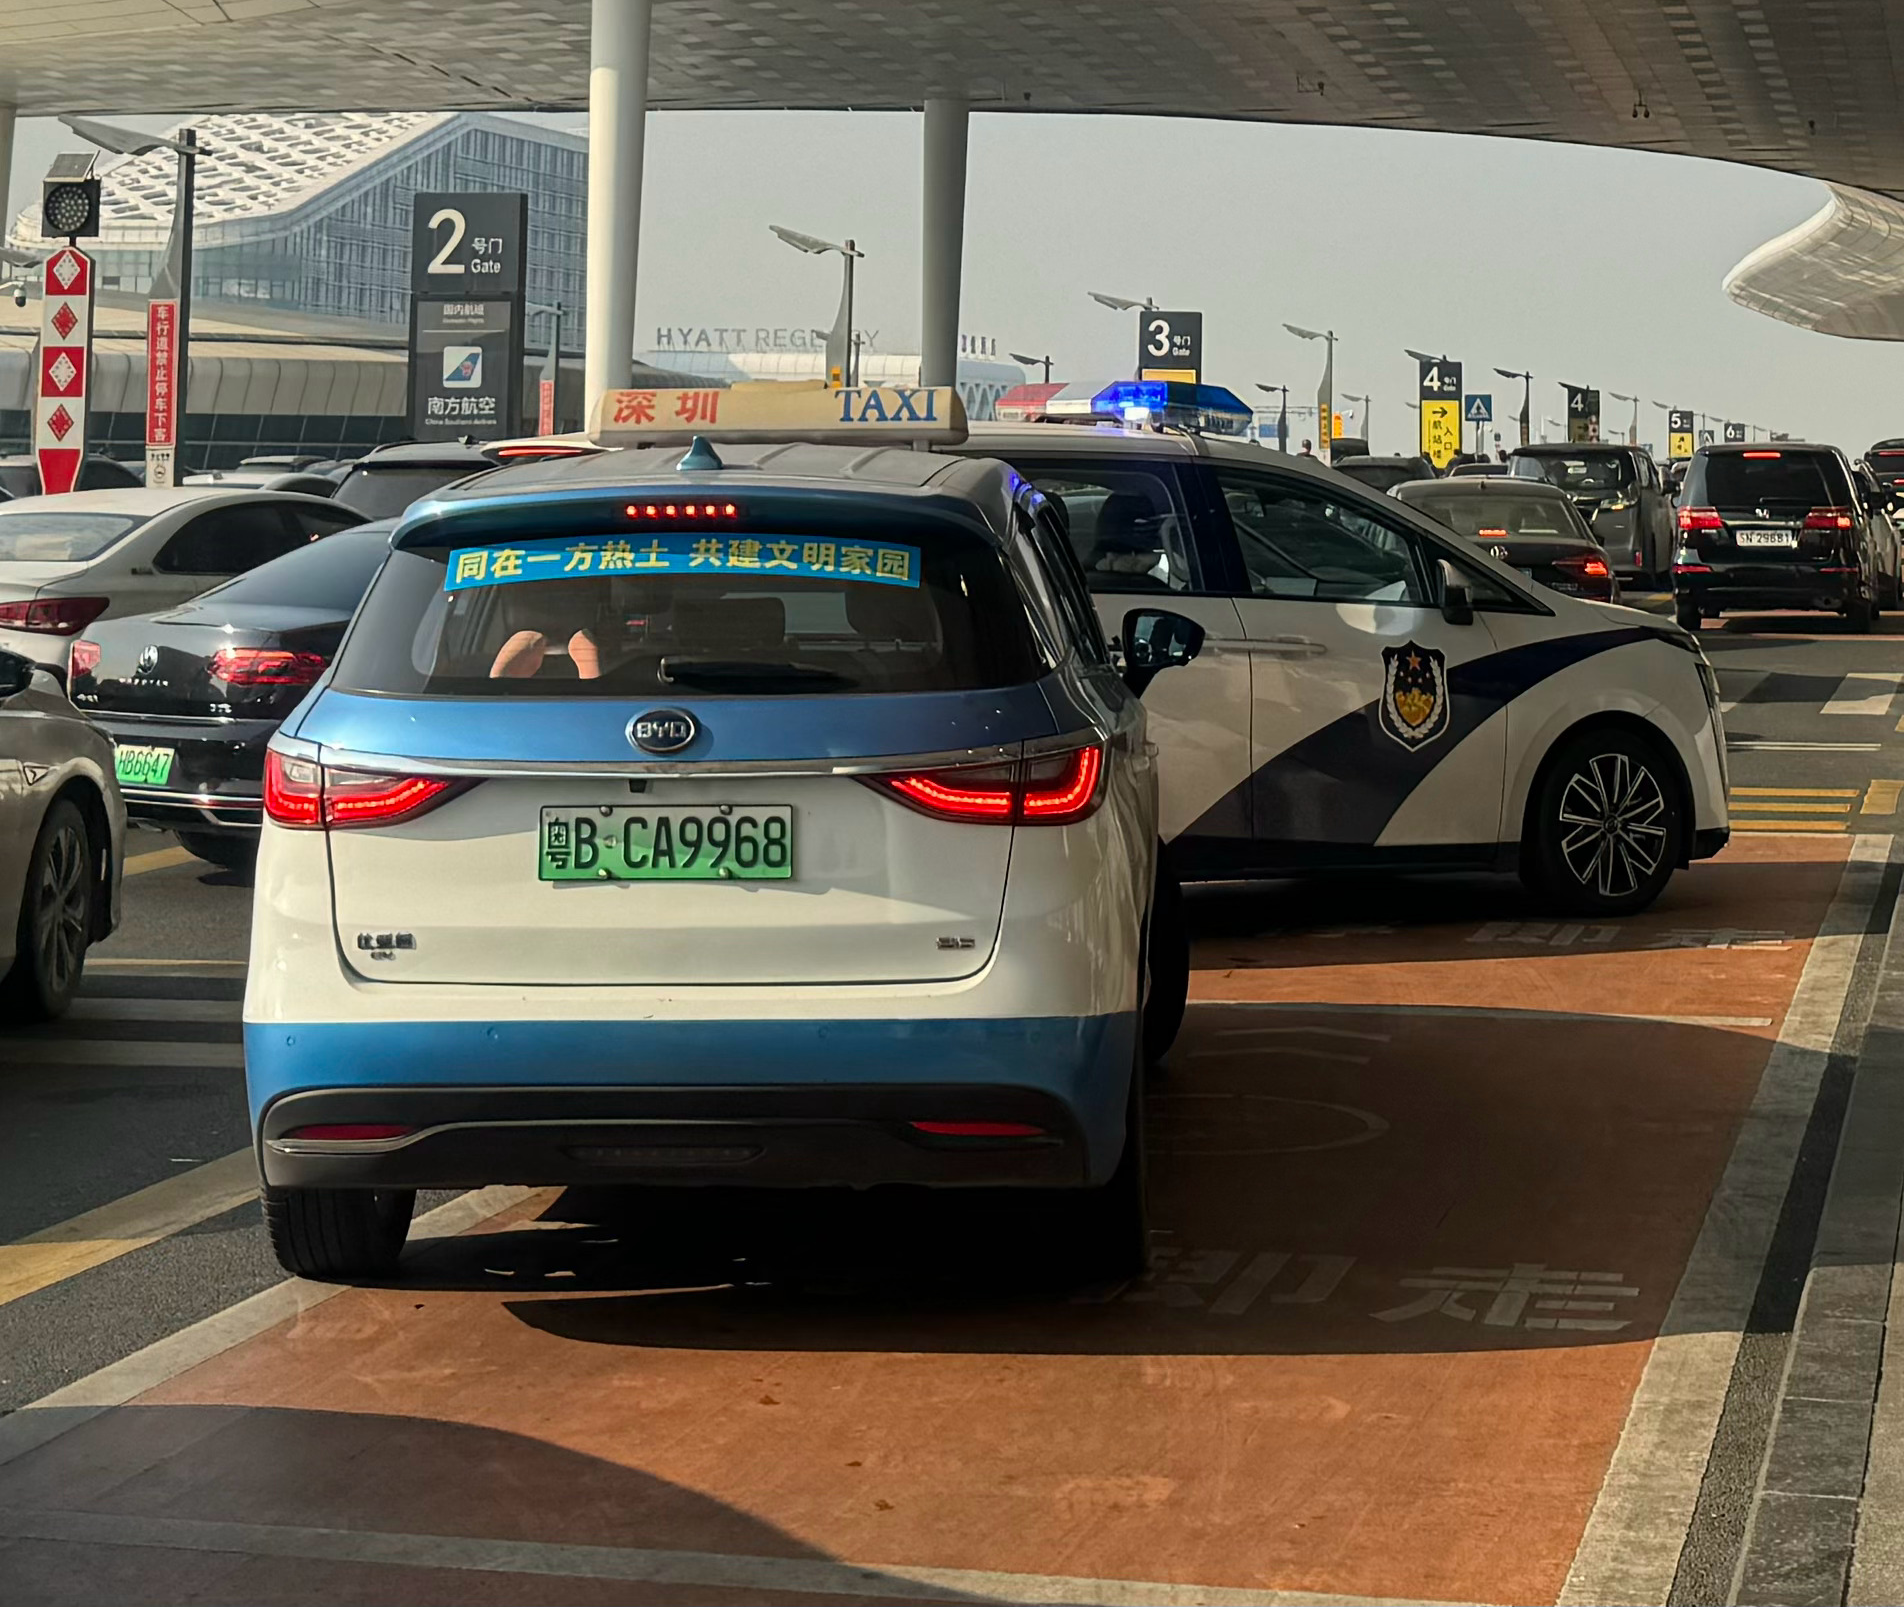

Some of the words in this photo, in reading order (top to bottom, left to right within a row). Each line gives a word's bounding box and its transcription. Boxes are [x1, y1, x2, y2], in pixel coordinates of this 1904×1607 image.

[427, 208, 466, 274] 2
[471, 237, 503, 255] 号门
[471, 258, 501, 274] Gate
[657, 327, 747, 348] HYATT
[1147, 319, 1170, 357] 3
[1423, 366, 1441, 392] 4
[427, 397, 496, 415] 南方航空
[613, 390, 720, 425] 深圳
[835, 389, 938, 423] TAXI
[1570, 393, 1584, 412] 4
[1671, 412, 1682, 429] 5
[1443, 426, 1453, 450] 入口
[1726, 425, 1735, 438] 6
[455, 538, 670, 583] 同在一方热土
[688, 538, 911, 582] 共建文明家园
[636, 720, 687, 739] BYD
